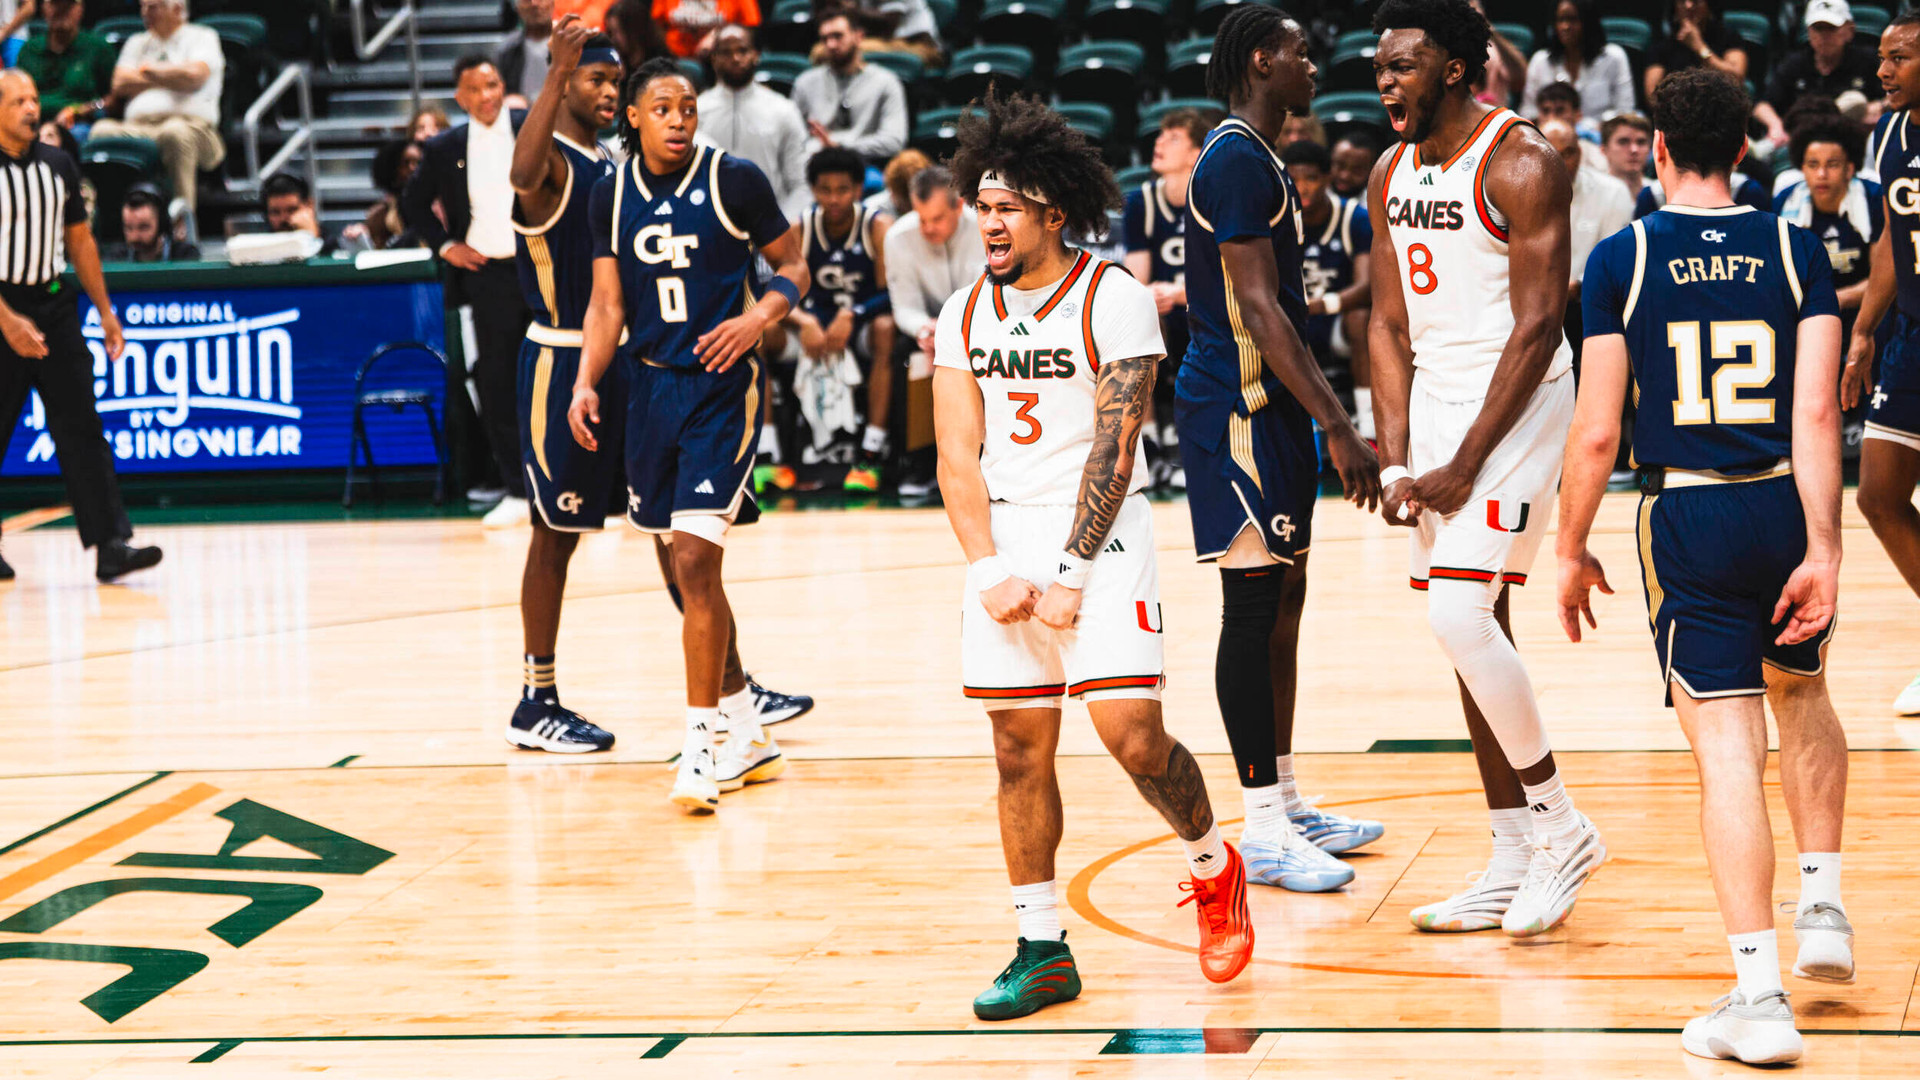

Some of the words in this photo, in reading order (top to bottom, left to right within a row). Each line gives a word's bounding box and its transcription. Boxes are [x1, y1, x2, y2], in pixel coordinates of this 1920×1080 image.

[1386, 196, 1464, 231] CANES
[1888, 177, 1920, 222] G
[633, 223, 699, 269] GT
[1701, 229, 1727, 243] GT
[1407, 242, 1439, 295] 8
[1668, 255, 1764, 285] CRAFT
[125, 302, 236, 324] ORIGINAL
[656, 276, 688, 323] 0
[970, 348, 1077, 380] CANES
[1667, 319, 1776, 426] 12
[130, 410, 153, 428] BY
[1007, 391, 1043, 446] 3
[556, 491, 583, 515] GT
[1486, 499, 1530, 533] U
[1271, 513, 1296, 542] GT
